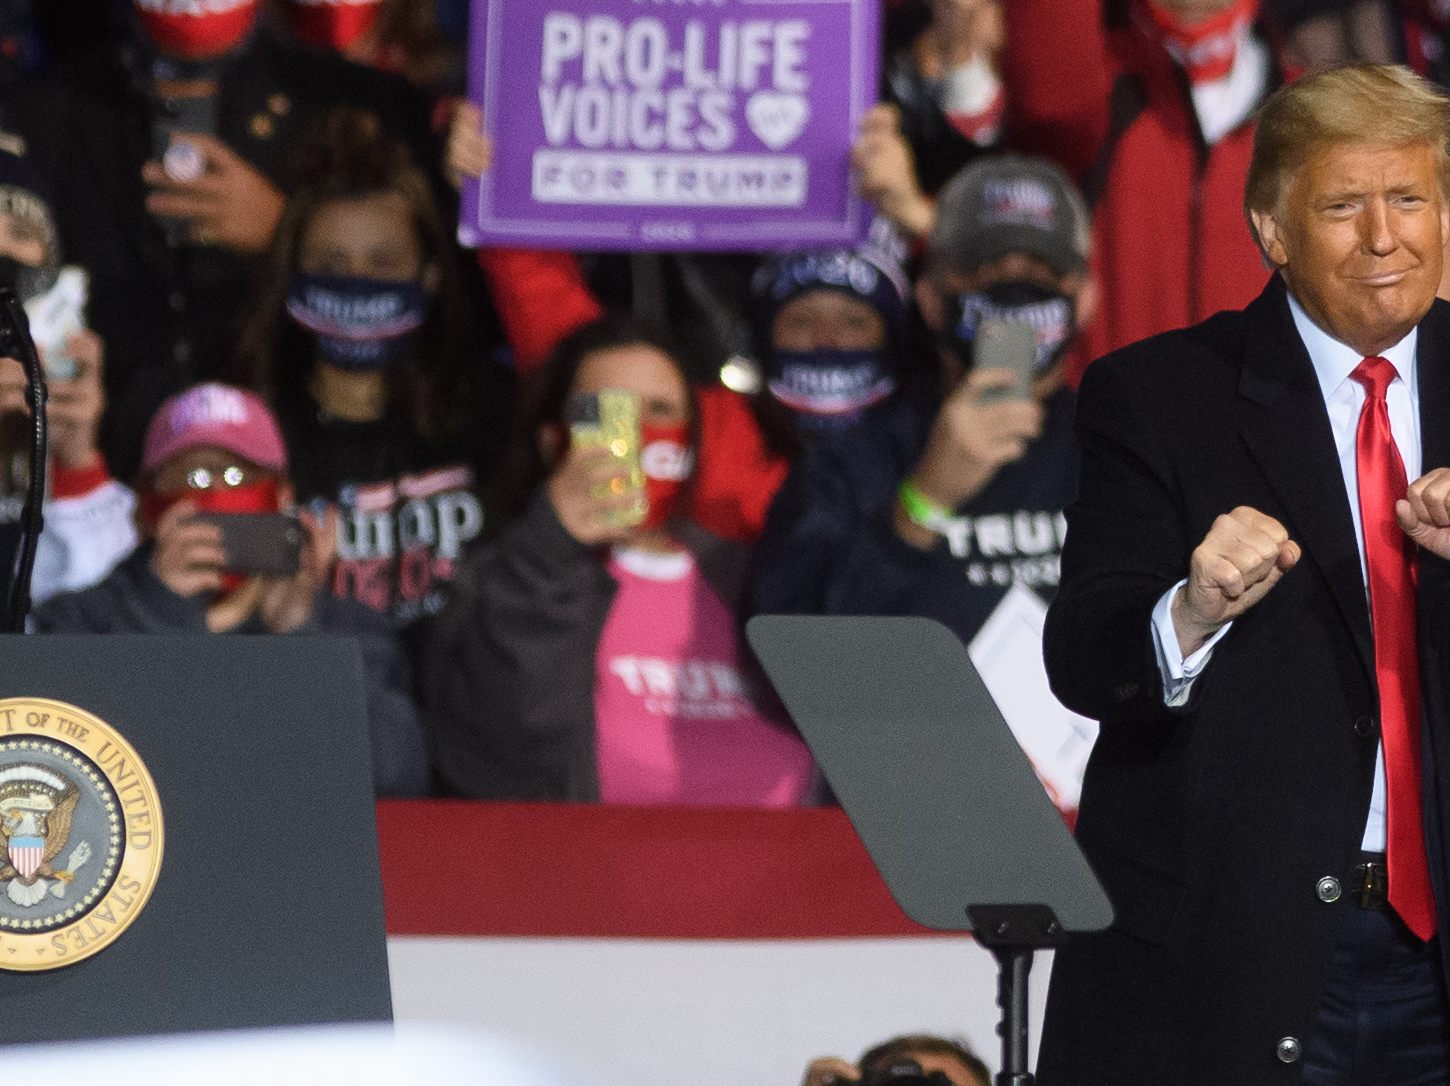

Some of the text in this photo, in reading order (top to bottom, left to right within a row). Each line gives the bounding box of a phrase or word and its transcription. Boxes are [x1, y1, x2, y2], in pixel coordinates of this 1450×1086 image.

[540, 12, 809, 91] PRO-LIFE
[540, 82, 734, 152] VOICES
[542, 164, 793, 198] FOR TRUMP
[26, 711, 50, 728] OF
[57, 717, 90, 743] THE
[97, 741, 152, 850] UNITED
[51, 873, 141, 957] STATES
